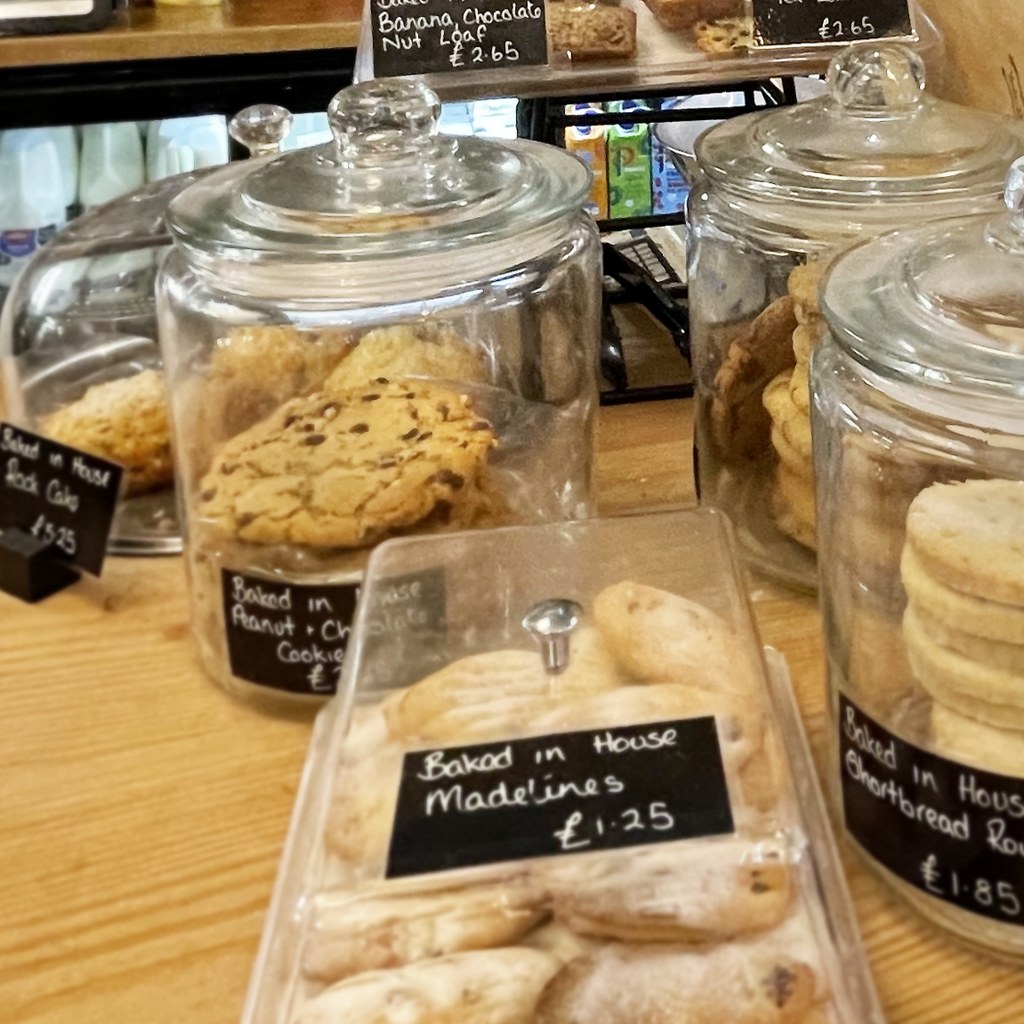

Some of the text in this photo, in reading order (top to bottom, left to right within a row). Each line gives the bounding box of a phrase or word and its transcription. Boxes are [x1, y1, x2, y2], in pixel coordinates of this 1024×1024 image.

[462, 0, 541, 24] Chocolate
[818, 16, 875, 38] £2.65
[382, 25, 487, 52] Nut Loaf
[0, 427, 112, 488] Baked in House
[6, 457, 80, 513] Rock Cake
[231, 575, 333, 612] Baked in
[231, 604, 295, 636] Peanut
[417, 728, 678, 781] Baked in House
[843, 706, 897, 770] Baked
[913, 764, 939, 792] in
[425, 774, 626, 816] Madelines
[845, 749, 970, 841] Shortbread
[553, 802, 675, 850] £1.25
[920, 853, 1021, 915] £1.85
